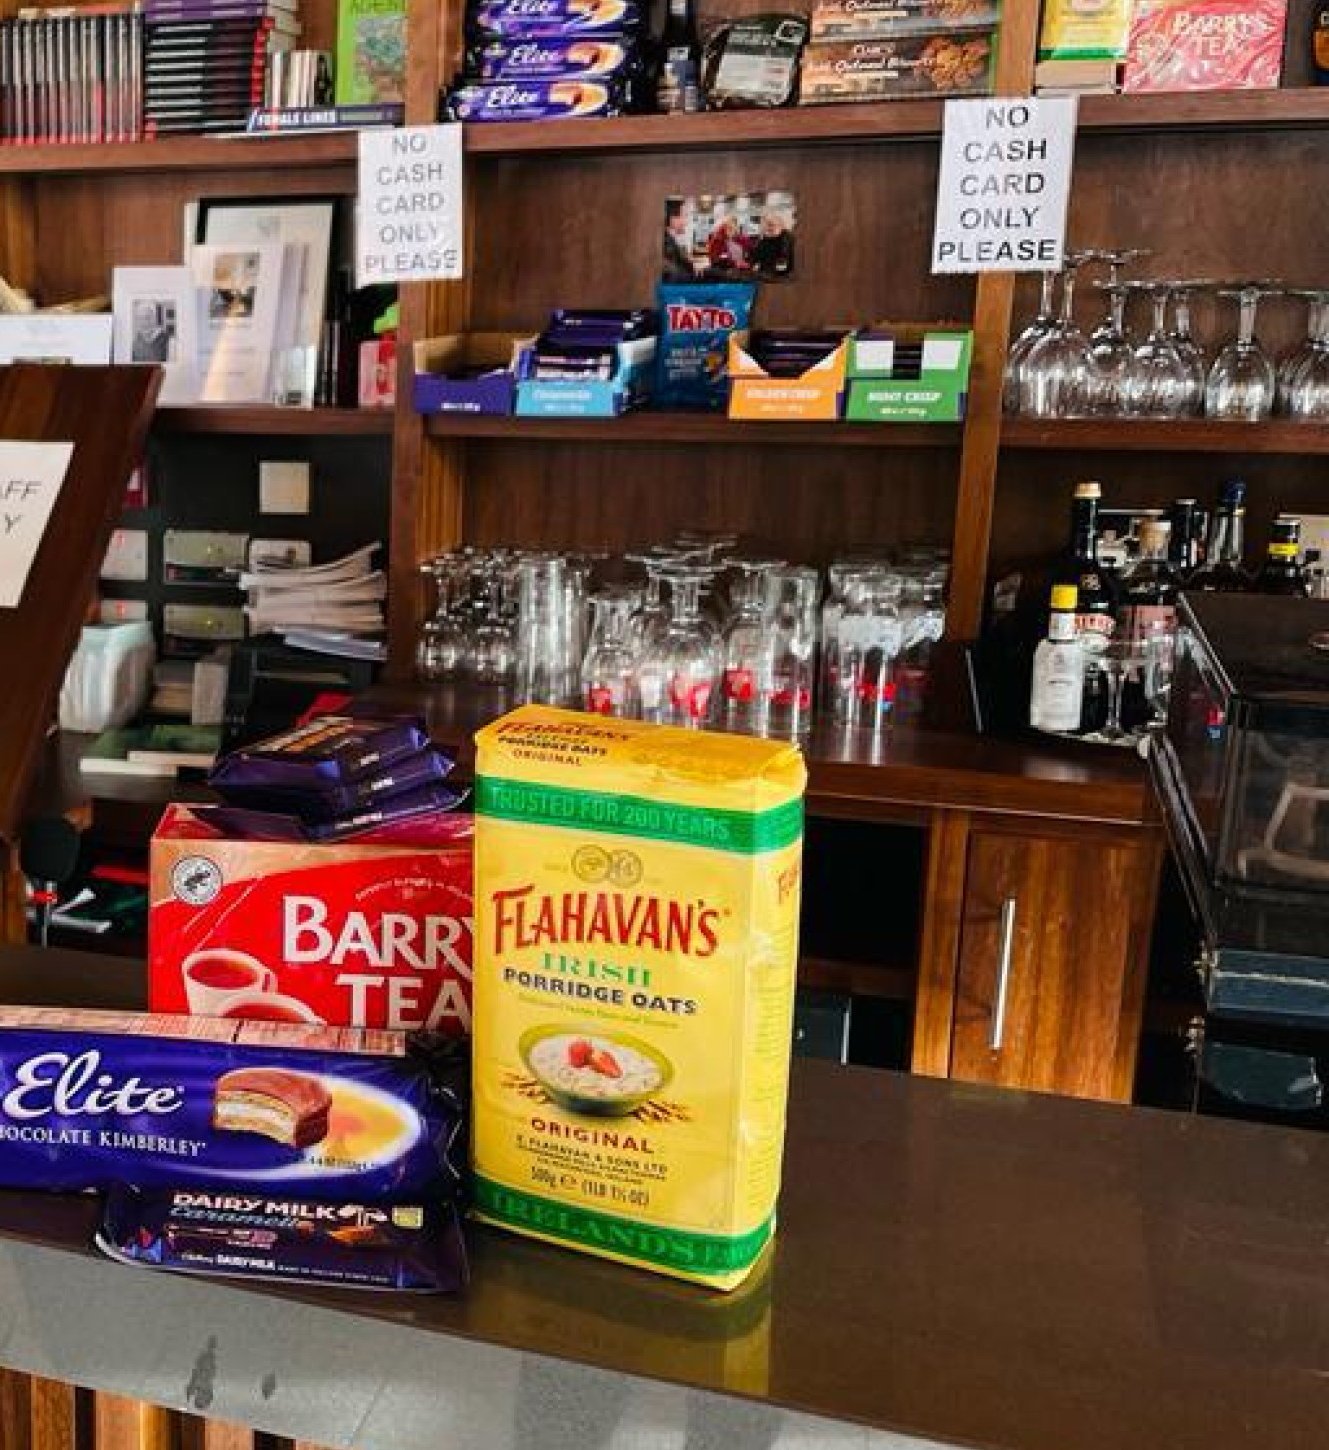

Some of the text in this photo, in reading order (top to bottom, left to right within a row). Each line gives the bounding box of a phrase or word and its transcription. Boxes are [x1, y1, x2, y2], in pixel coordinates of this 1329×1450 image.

[508, 44, 560, 66] Elite
[487, 83, 539, 108] Elite
[986, 106, 1029, 128] NO
[393, 133, 427, 154] NO
[963, 138, 1047, 162] CASH
[376, 163, 442, 185] CASH
[960, 172, 1045, 196] CARD
[376, 193, 445, 215] CARD
[960, 206, 1039, 229] ONLY
[379, 222, 438, 244] ONLY
[365, 250, 458, 273] PLEASE
[939, 239, 1057, 263] PLEASE
[666, 304, 737, 333] TAYTO
[490, 785, 729, 841] TRUSTED FOR 200 YEARS
[492, 884, 719, 957] FLAHAVAN'S
[542, 952, 651, 988] IRISH
[334, 973, 475, 1031] TEA
[500, 965, 697, 1015] PORRIDGE OATS
[2, 1049, 184, 1119] Elite
[100, 1131, 202, 1157] KIMBERLEY
[531, 1117, 654, 1154] ORIGINAL
[173, 1193, 336, 1220] DAIRY MILK
